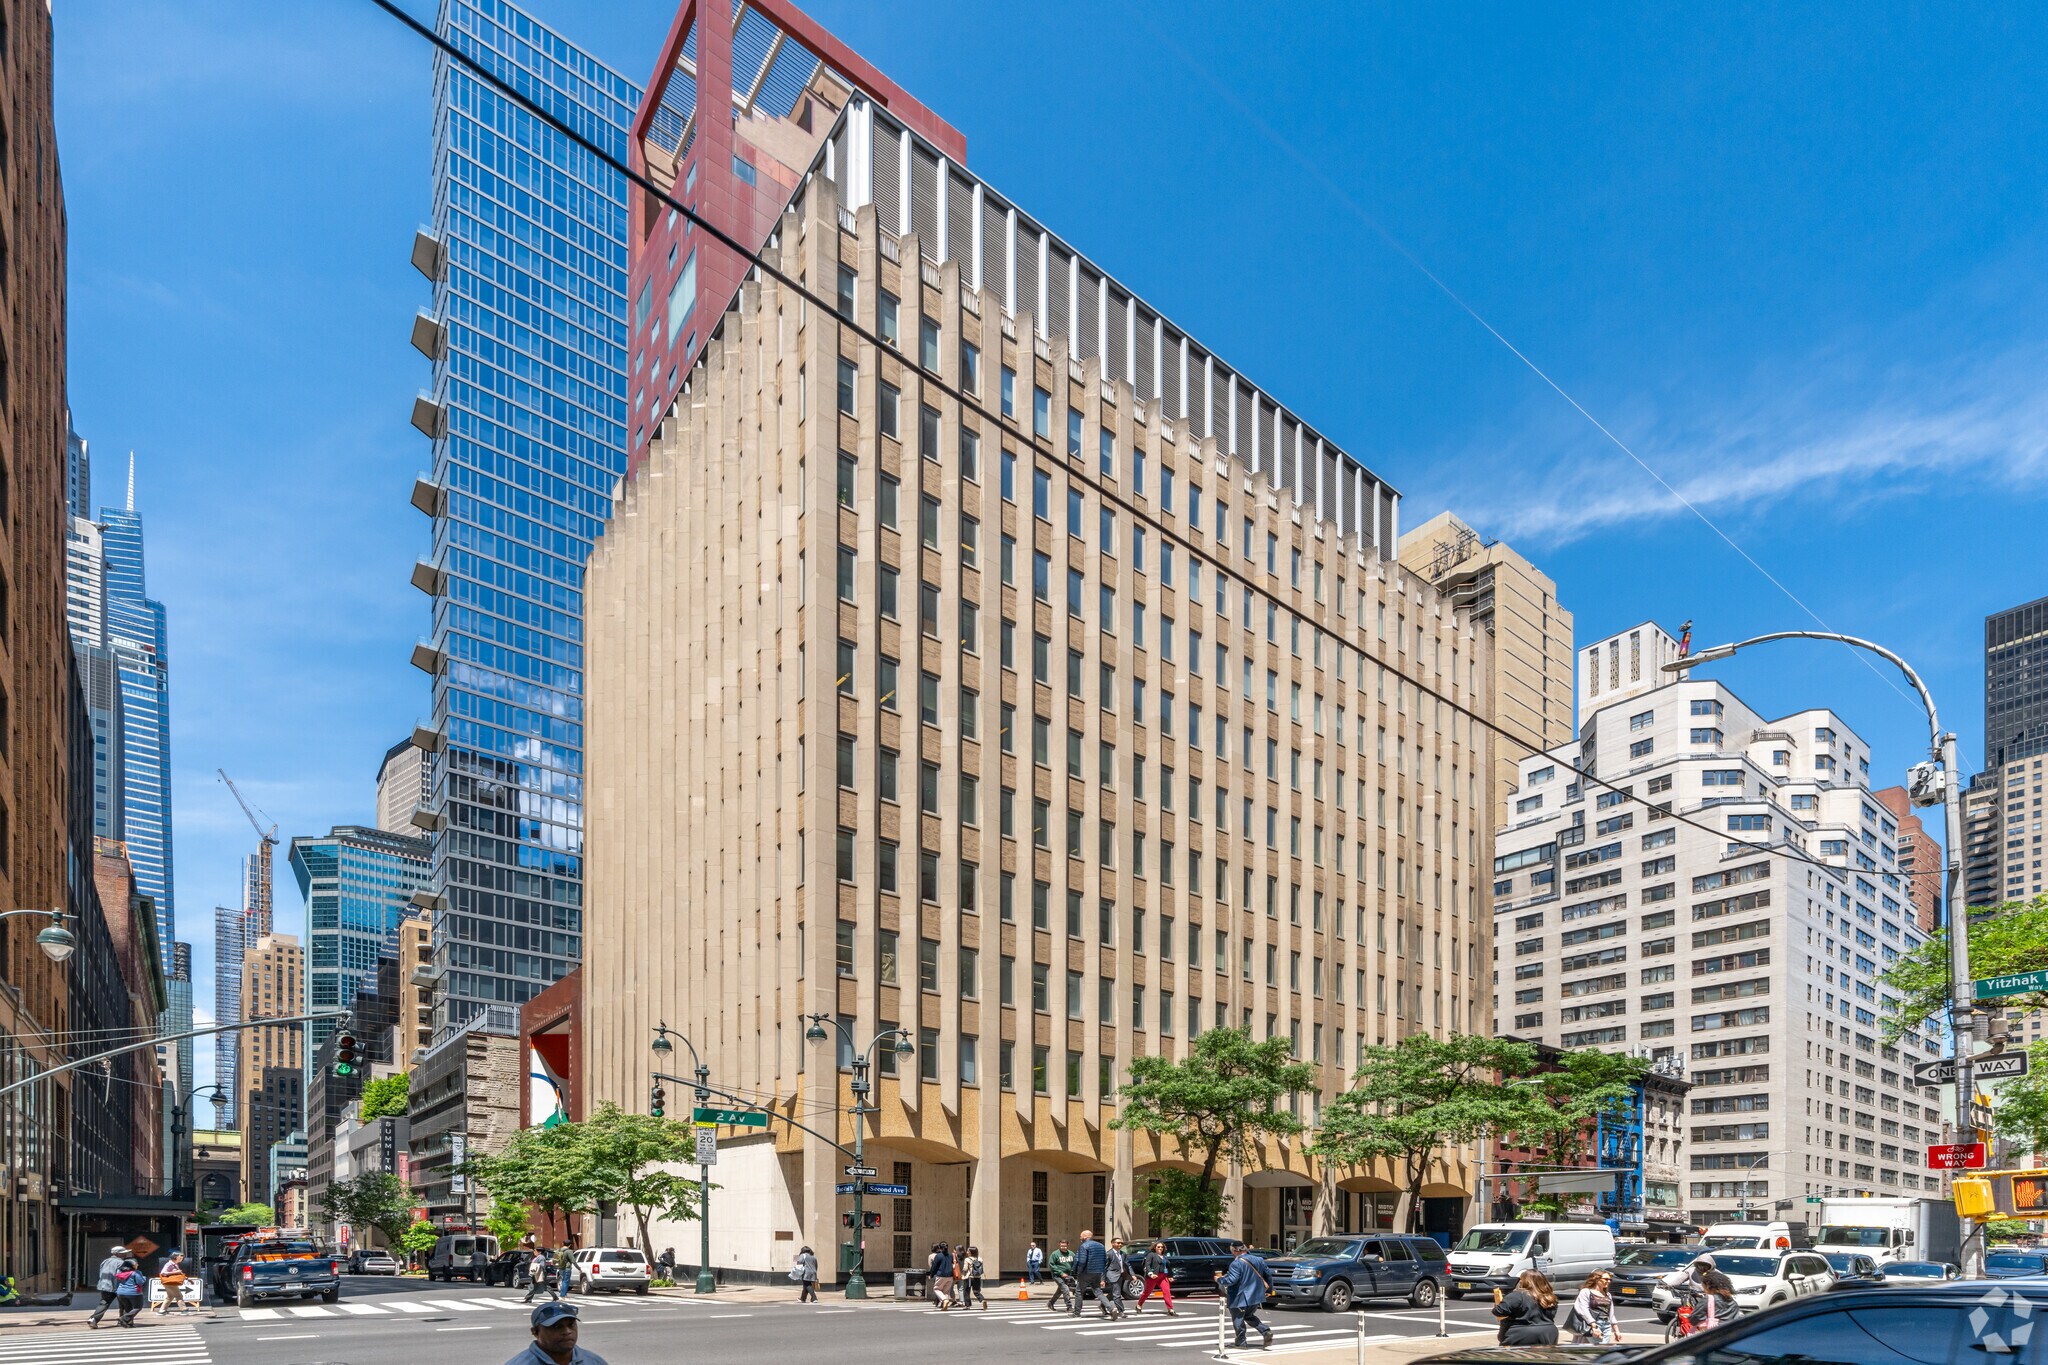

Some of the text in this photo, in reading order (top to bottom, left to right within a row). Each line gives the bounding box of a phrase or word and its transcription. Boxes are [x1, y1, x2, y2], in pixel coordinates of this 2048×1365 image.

[1986, 974, 2039, 990] Yitzhak
[1928, 1066, 1956, 1079] ONE
[1979, 1060, 2016, 1073] WAY
[716, 1112, 745, 1123] 2 Av
[1937, 1152, 1975, 1161] WRONG
[869, 1185, 905, 1194] Second Ave
